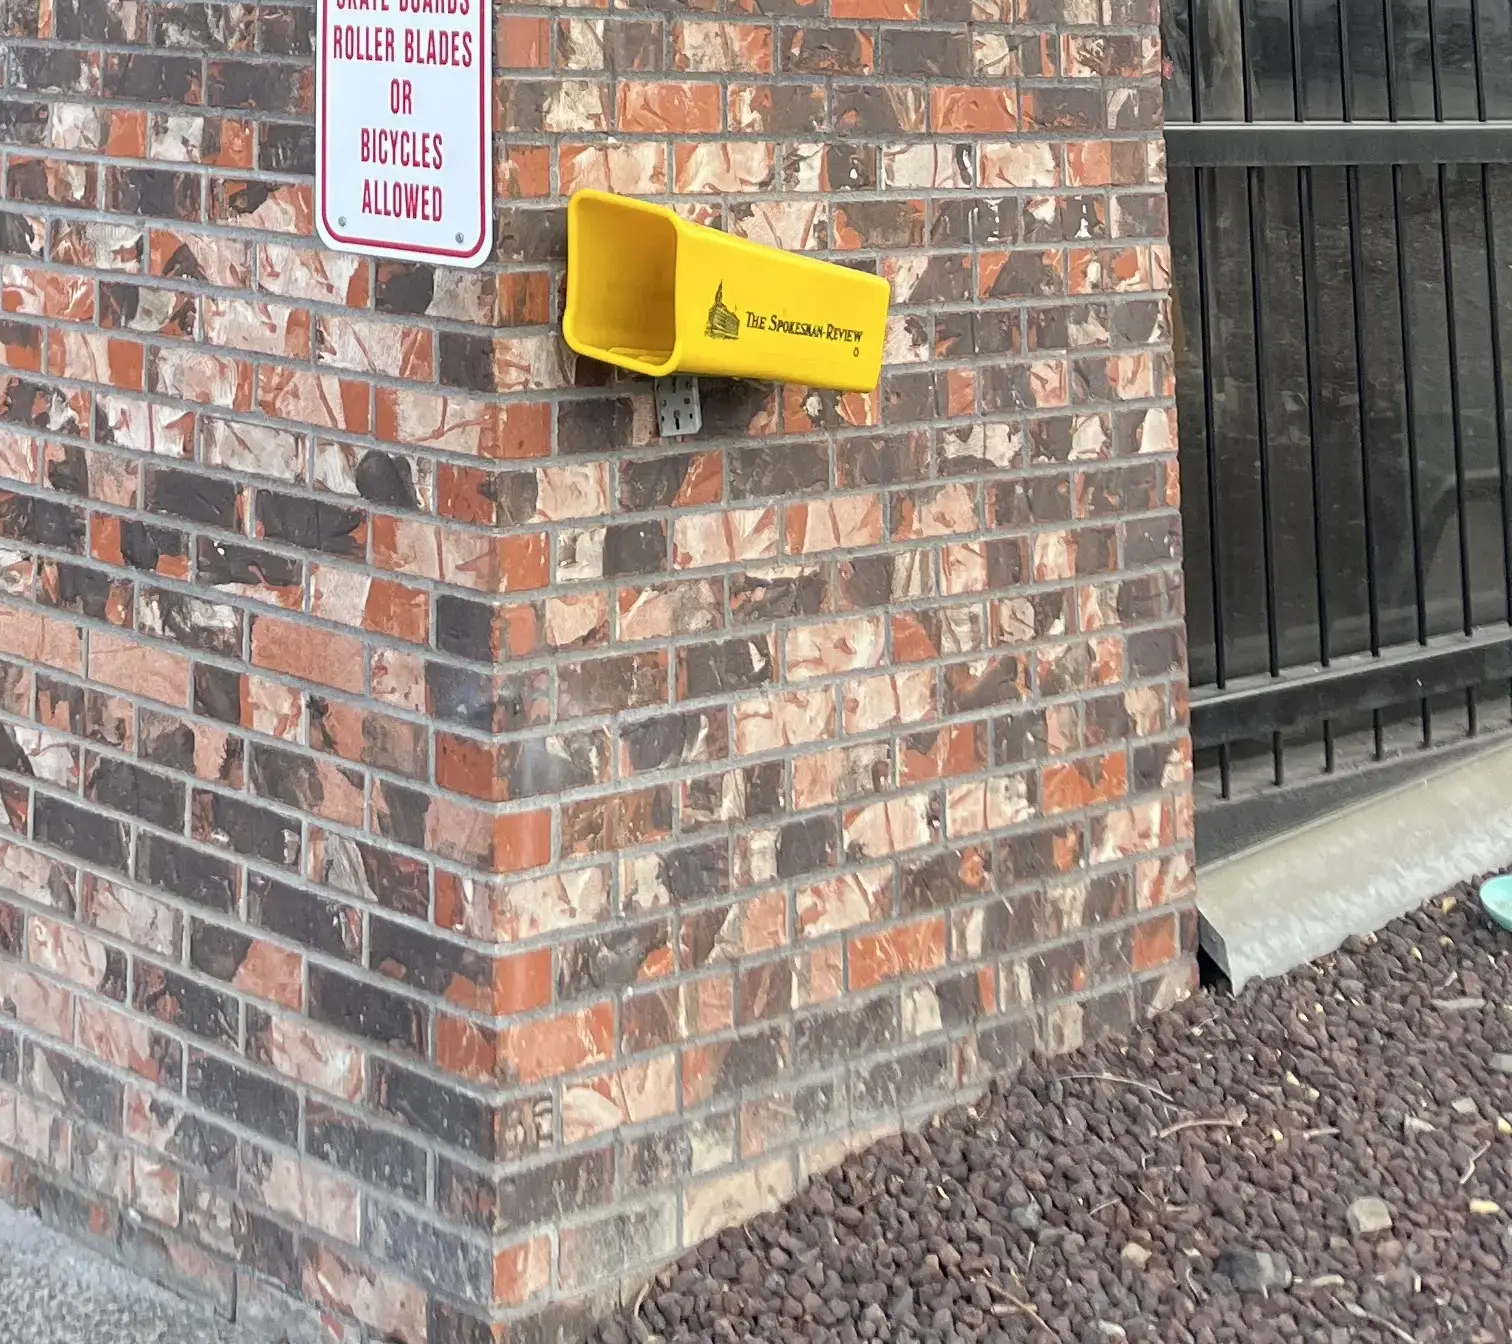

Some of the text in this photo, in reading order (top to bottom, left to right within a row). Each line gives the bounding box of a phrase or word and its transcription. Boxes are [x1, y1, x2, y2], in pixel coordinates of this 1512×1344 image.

[333, 24, 473, 68] ROLLER BLADES
[390, 78, 413, 114] OR
[360, 127, 443, 170] BICYCLES
[361, 178, 443, 222] ALLOWED
